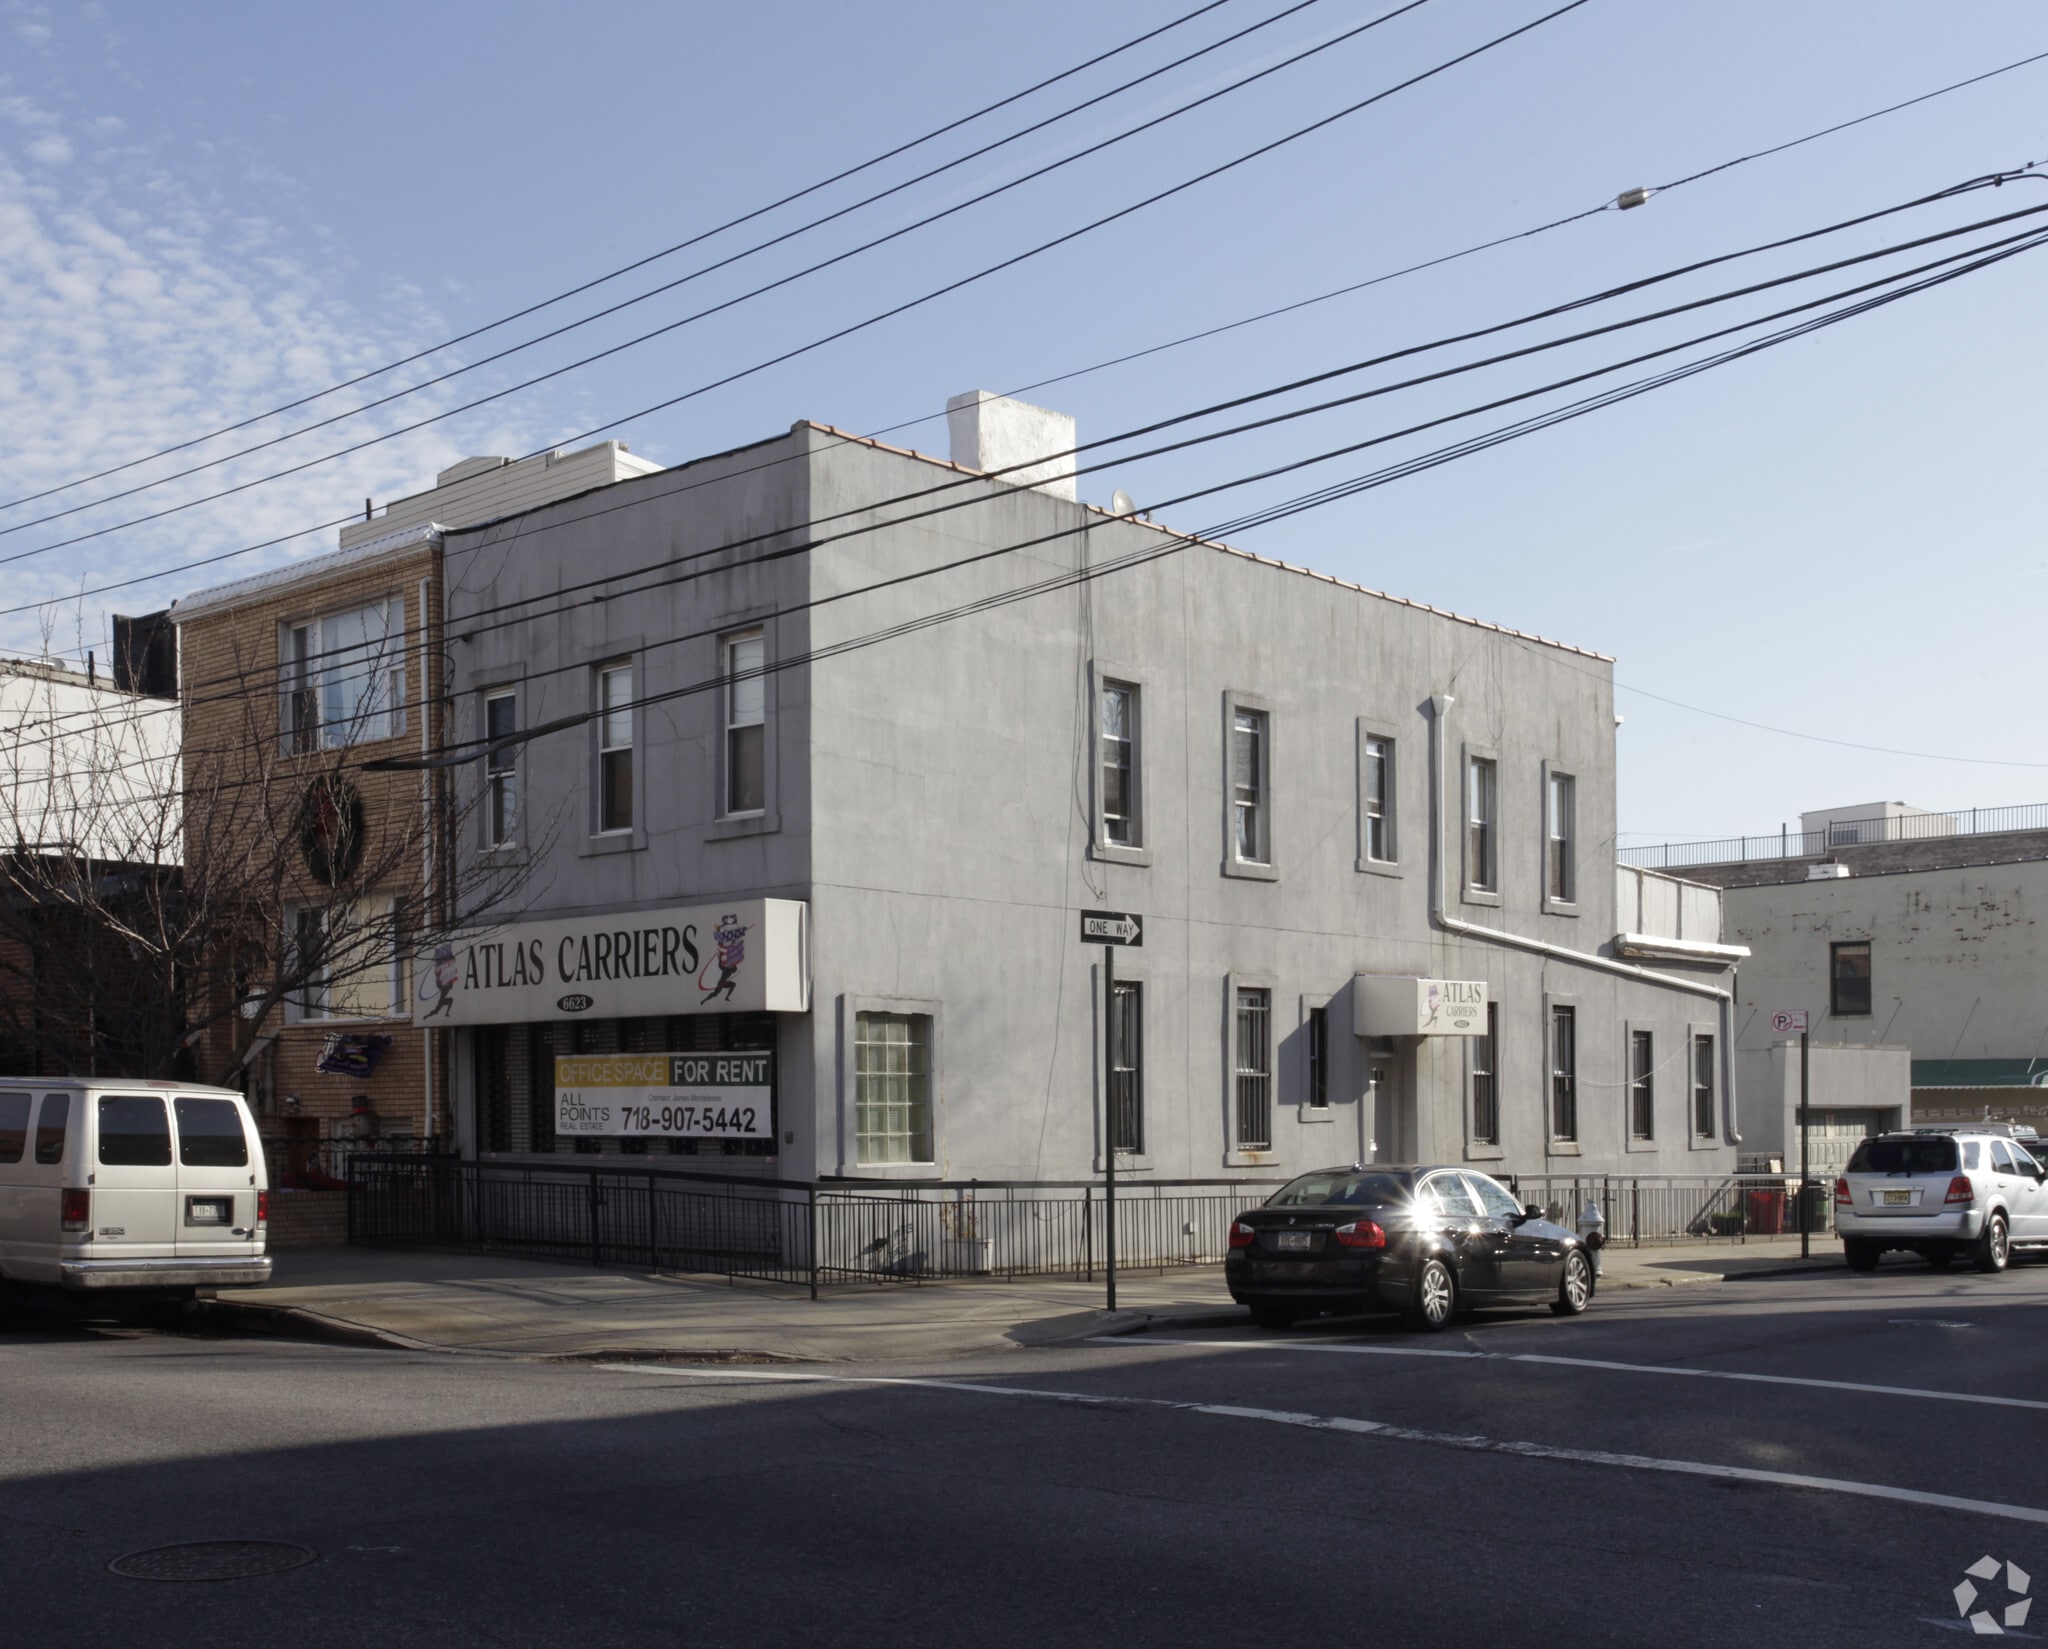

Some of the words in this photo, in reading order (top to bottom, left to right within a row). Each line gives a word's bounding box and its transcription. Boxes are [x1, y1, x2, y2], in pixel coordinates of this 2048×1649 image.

[1090, 920, 1108, 934] ONE
[1116, 922, 1134, 936] WAY
[463, 939, 545, 990] ATLAS
[558, 924, 699, 983] CARRIERS
[1443, 983, 1482, 1003] ATLAS
[562, 996, 588, 1010] 6623
[1446, 1005, 1478, 1017] CARRIERS
[560, 1062, 612, 1082] OFFICE
[614, 1061, 664, 1081] SPACE
[674, 1061, 710, 1082] FOR
[716, 1059, 767, 1082] RENT
[560, 1092, 586, 1106] ALL
[560, 1107, 610, 1121] POINTS
[621, 1106, 756, 1133] 718-907-5442
[560, 1122, 577, 1130] REAL
[580, 1122, 604, 1130] ESTATE
